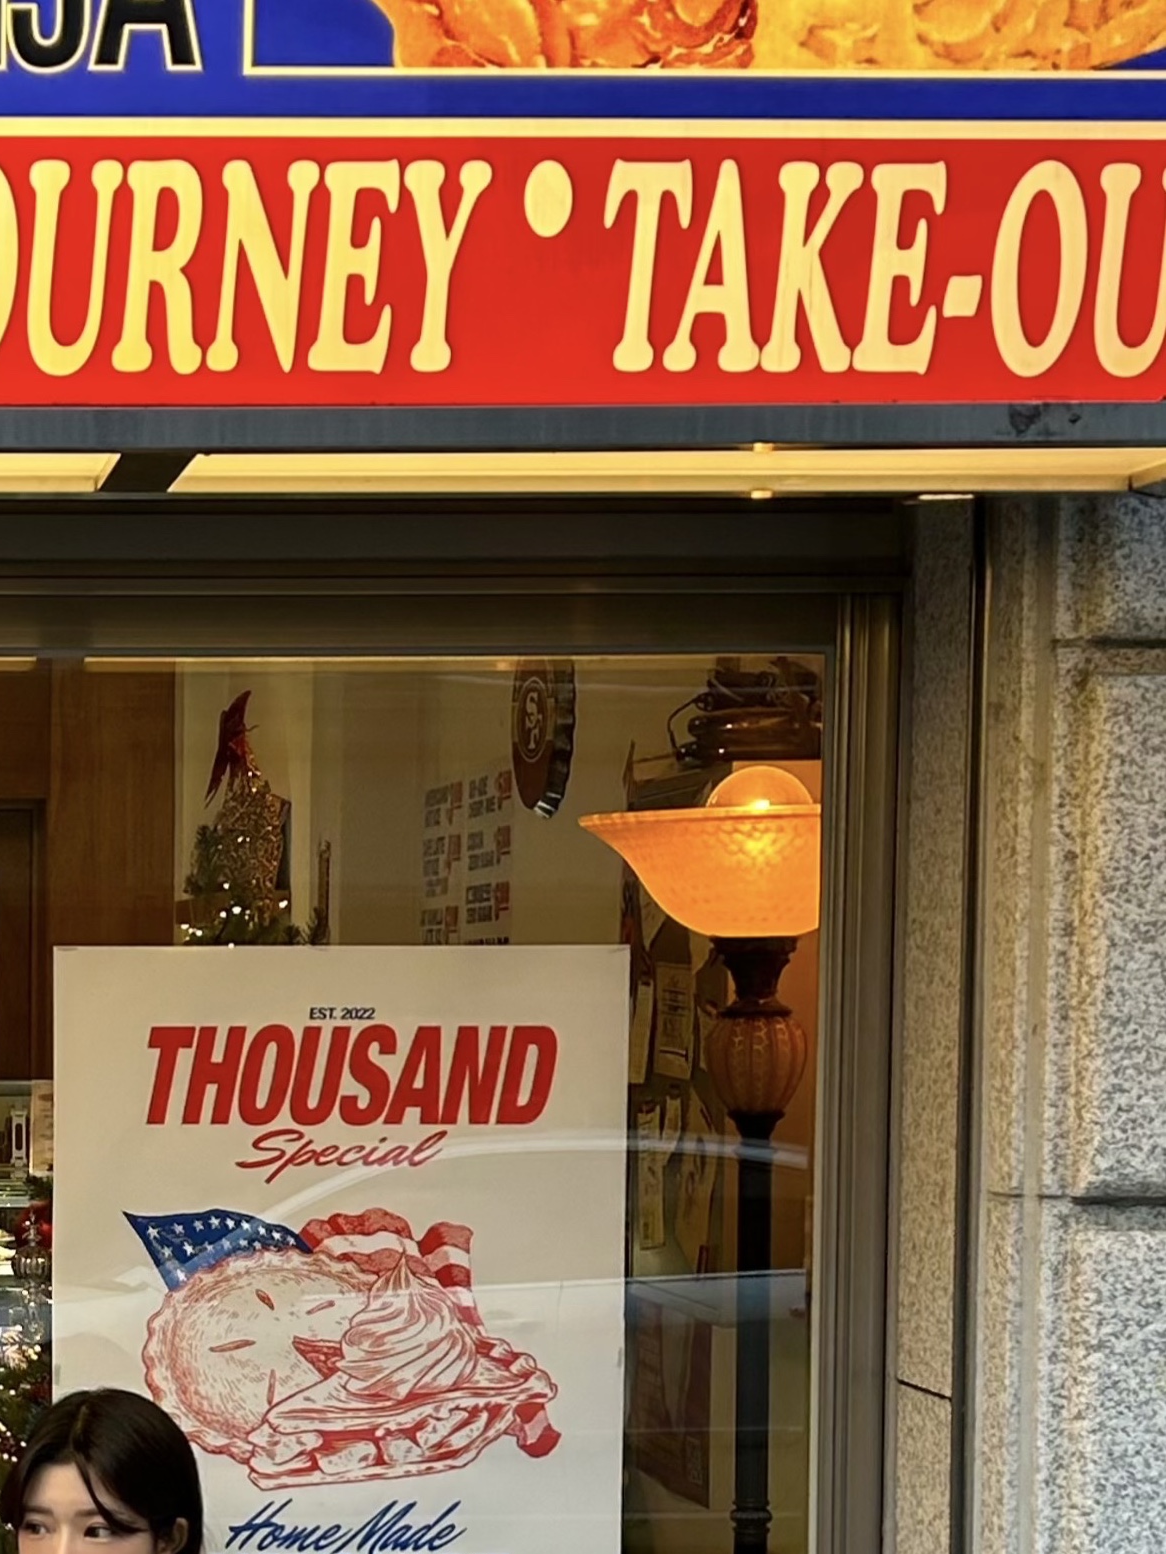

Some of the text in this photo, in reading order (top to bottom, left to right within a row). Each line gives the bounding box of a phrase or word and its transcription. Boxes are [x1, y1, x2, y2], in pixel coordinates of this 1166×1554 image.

[604, 158, 1166, 378] TAKE-OU
[309, 1007, 376, 1021] EST. 2022
[146, 1023, 558, 1127] THOUSAND
[235, 1128, 448, 1185] Special
[225, 1497, 468, 1554] Home Made
